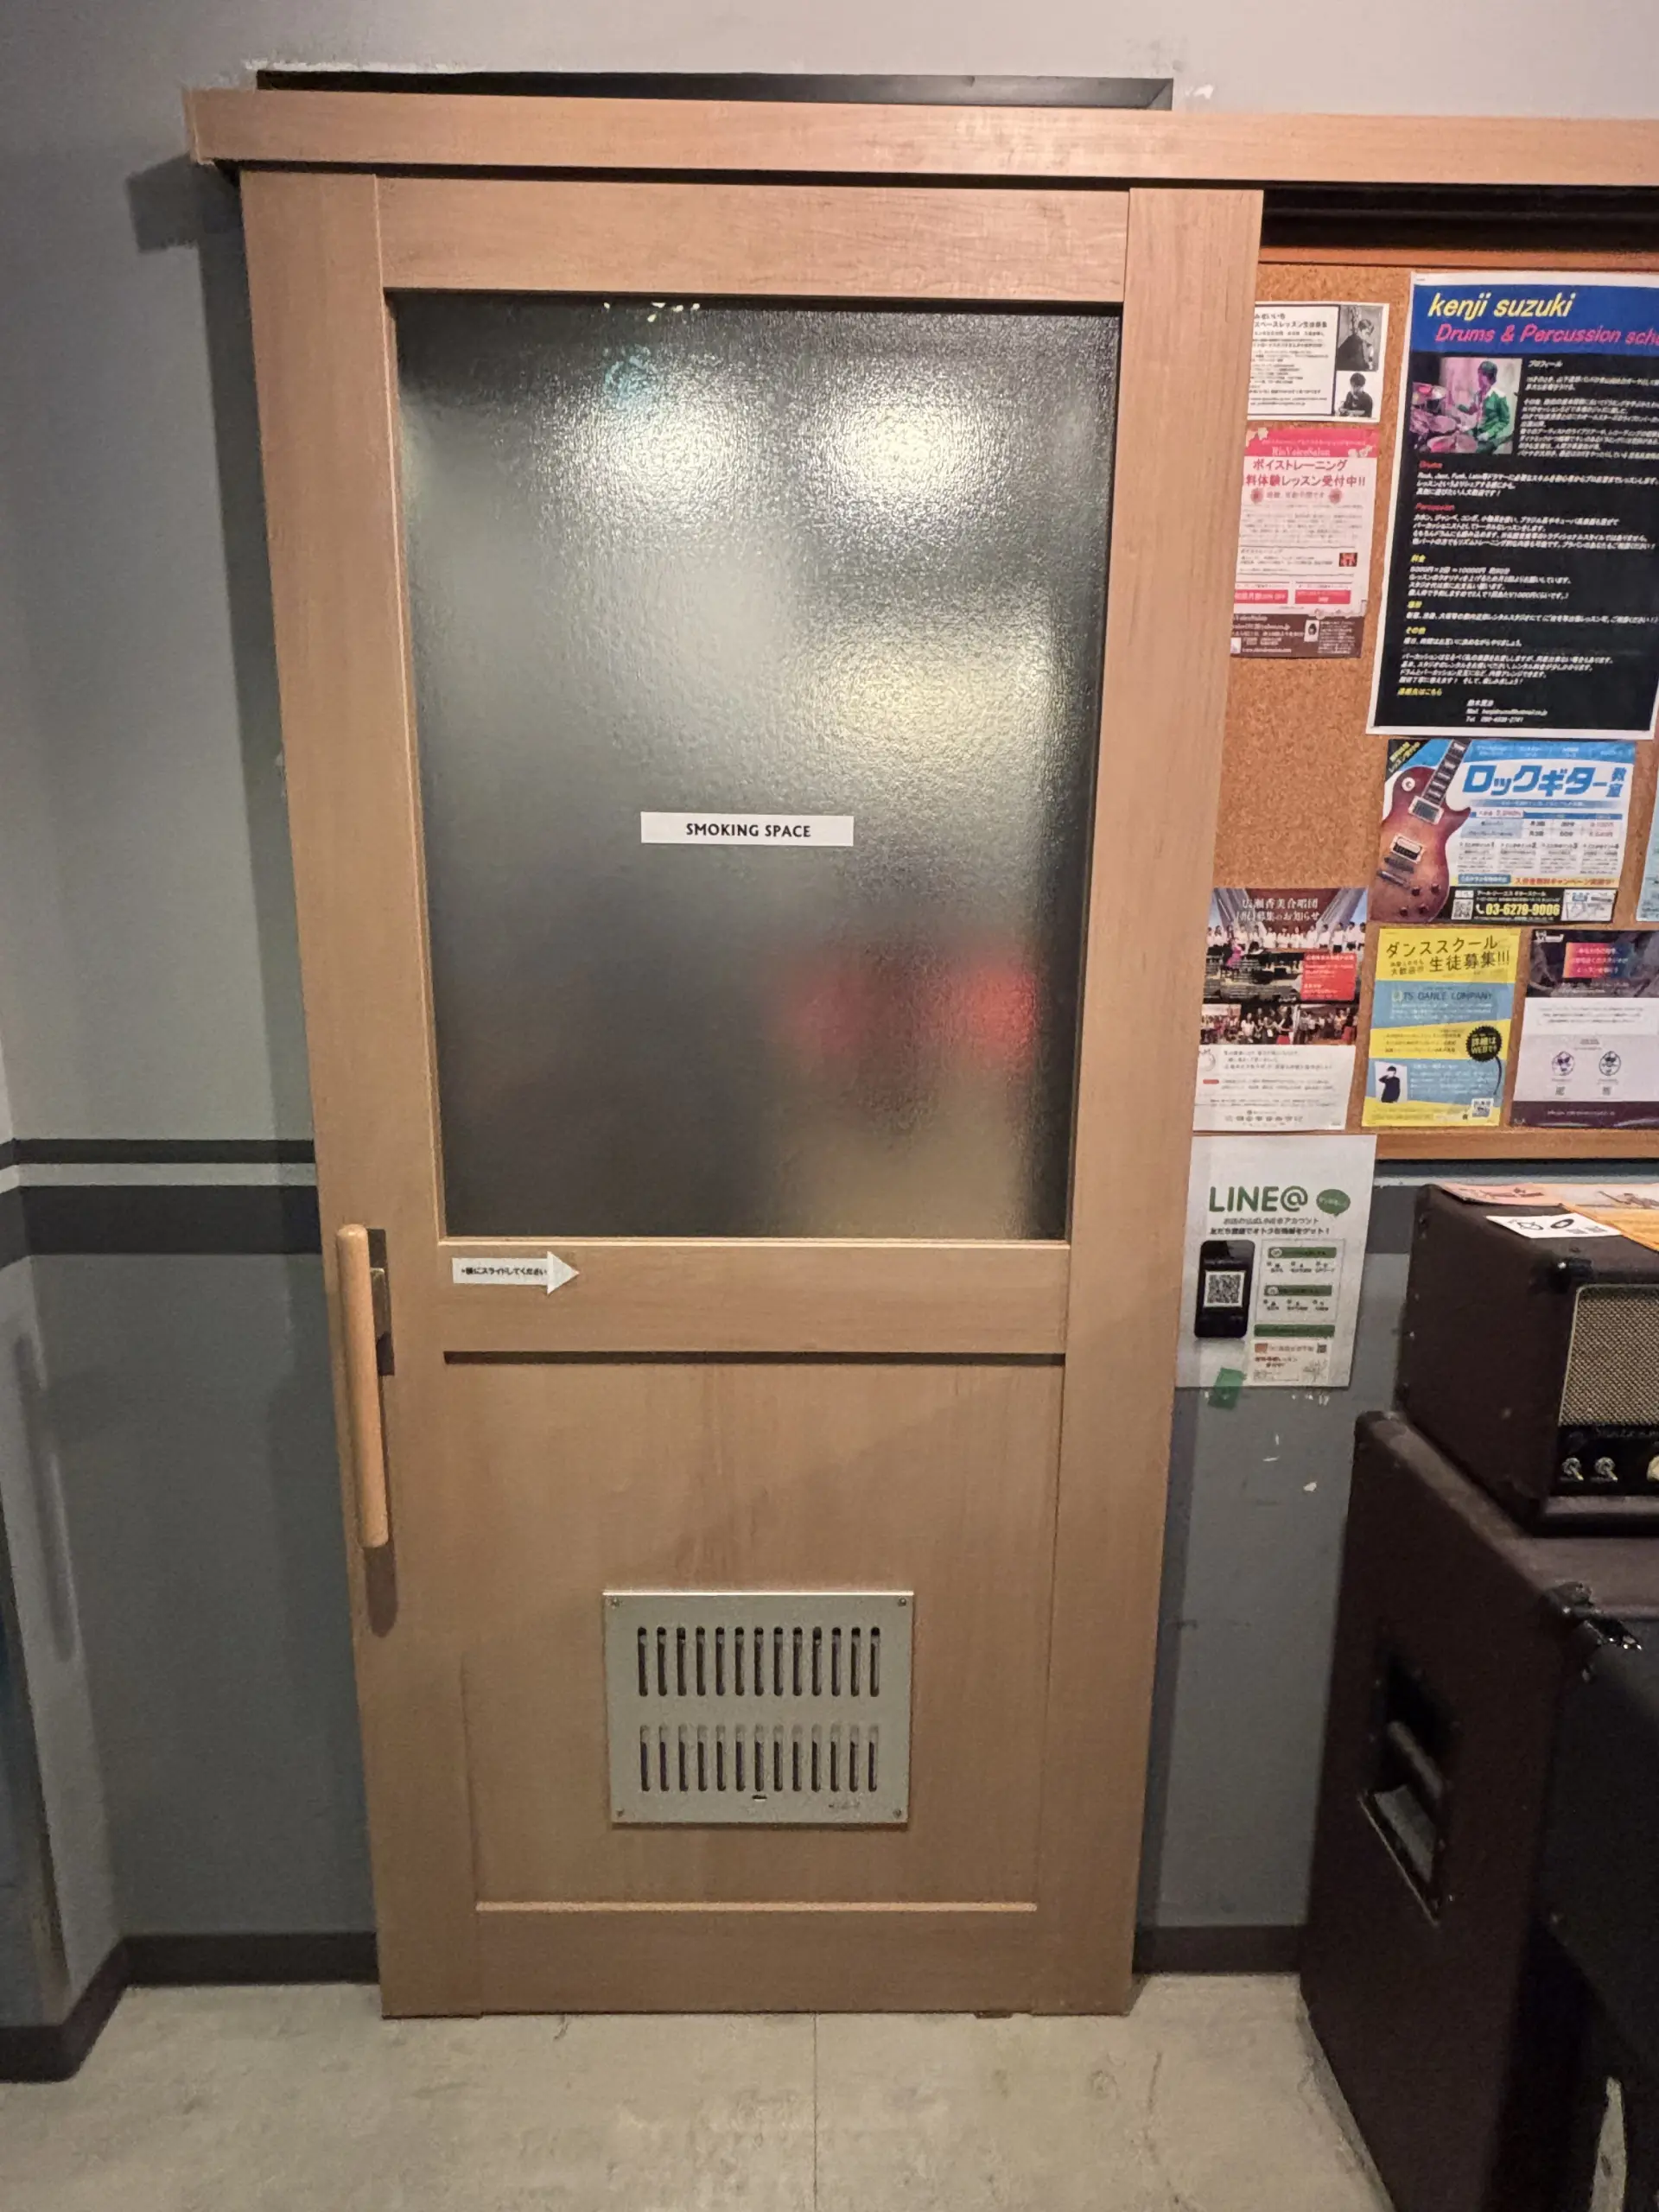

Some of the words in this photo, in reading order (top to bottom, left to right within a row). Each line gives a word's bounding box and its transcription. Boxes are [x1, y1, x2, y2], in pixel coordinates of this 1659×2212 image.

[1427, 292, 1492, 321] kenji
[1493, 292, 1577, 318] suzuki
[1434, 323, 1496, 343] Drums
[1500, 323, 1516, 343] &
[1519, 323, 1622, 344] Percussion
[1462, 764, 1608, 797] ロックギター
[686, 823, 760, 837] SMOKING
[764, 824, 811, 838] SPACE
[1386, 934, 1498, 959] ダンススクール
[1209, 1185, 1309, 1212] LINE@
